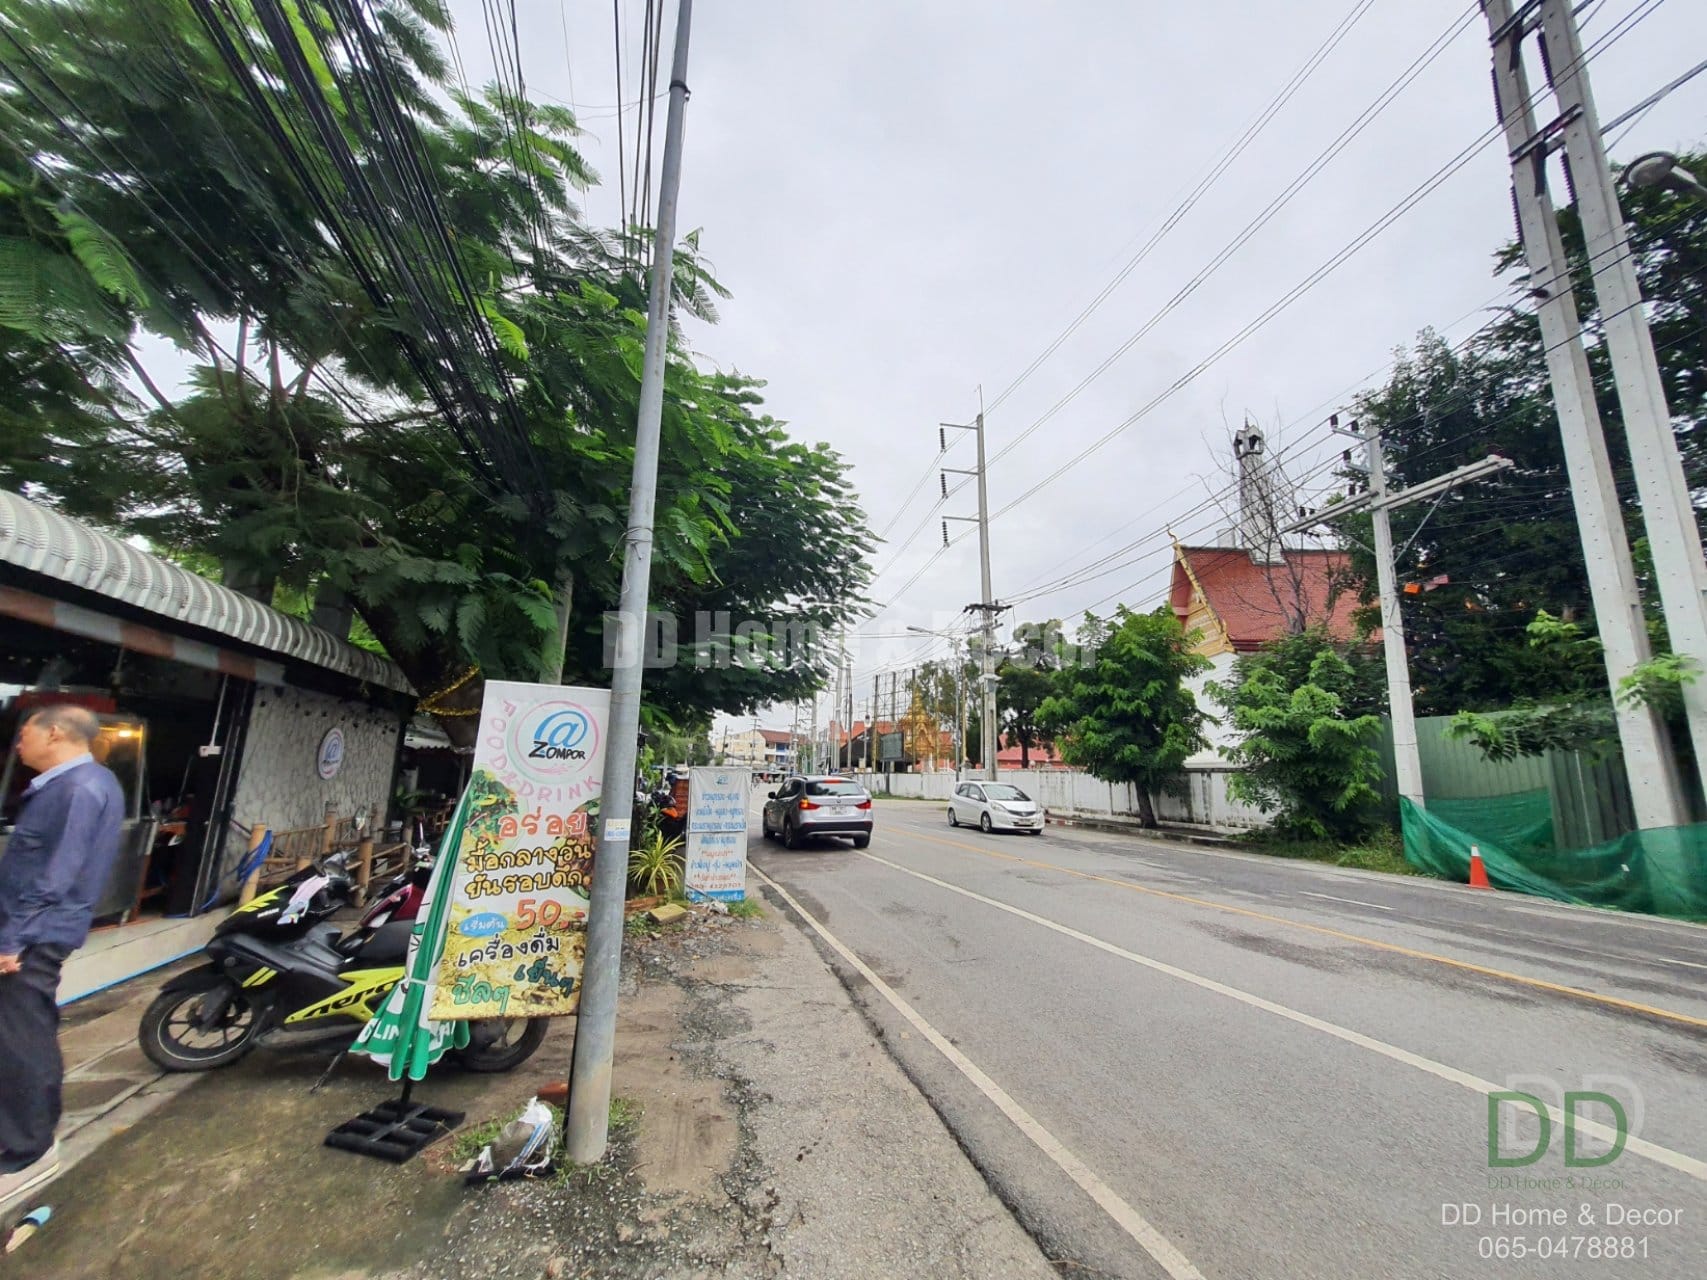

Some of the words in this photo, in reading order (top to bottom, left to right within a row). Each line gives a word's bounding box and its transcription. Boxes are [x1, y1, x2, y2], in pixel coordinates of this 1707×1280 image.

[498, 806, 587, 837] อร่อย
[467, 838, 592, 872] มื้อกลางวัน
[458, 928, 559, 967] เครื่องดื่ม
